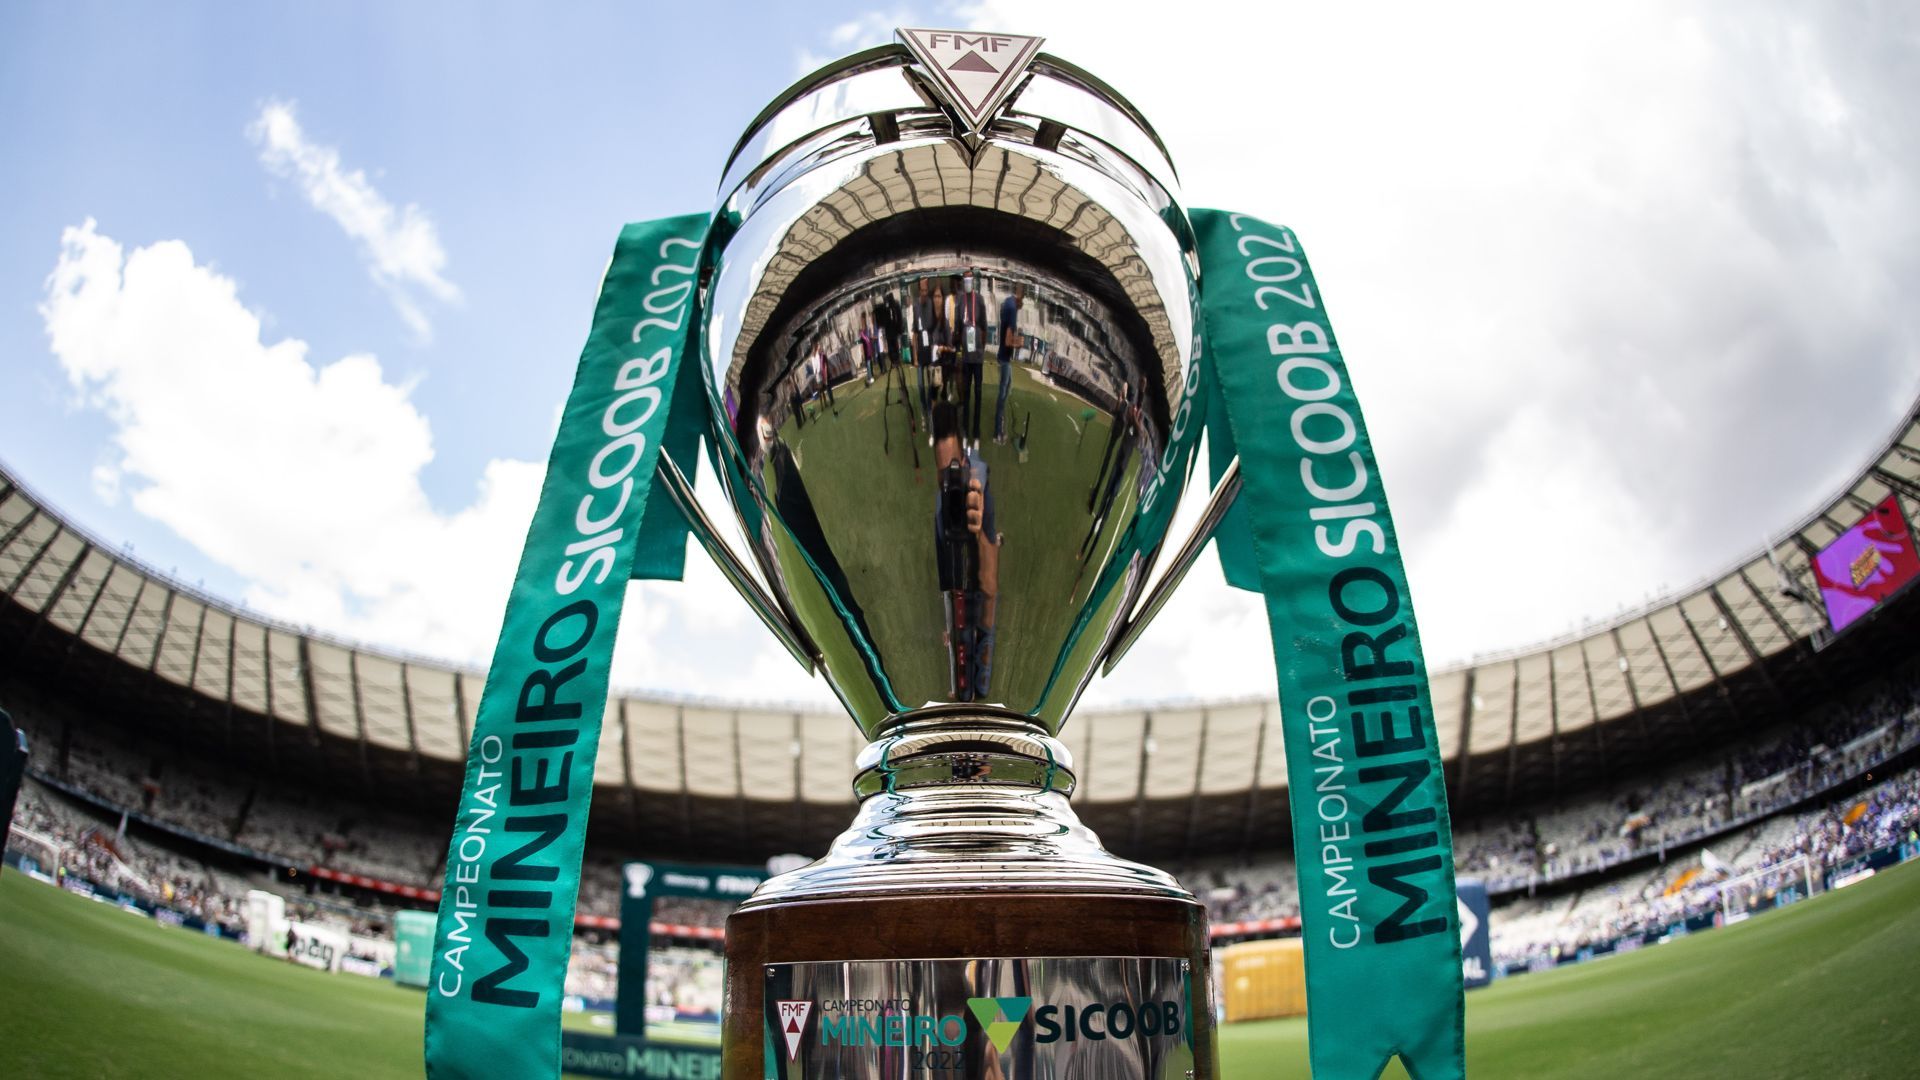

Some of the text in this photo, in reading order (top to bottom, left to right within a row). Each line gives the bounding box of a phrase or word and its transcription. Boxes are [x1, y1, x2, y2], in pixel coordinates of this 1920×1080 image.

[930, 33, 1012, 53] FMF
[1266, 320, 1386, 558] SICOOB
[470, 237, 702, 1009] MINEIRO SICOOB 2022
[1328, 566, 1448, 945] MINEIRO
[1306, 695, 1361, 950] CAMPEONATO
[438, 734, 503, 998] CAMPEONATO
[781, 1003, 806, 1017] FMF
[822, 999, 912, 1012] CAMPEONATO
[1034, 1000, 1181, 1044] SICOOB
[822, 1014, 968, 1047] MINEIRO
[911, 1050, 967, 1070] 2022
